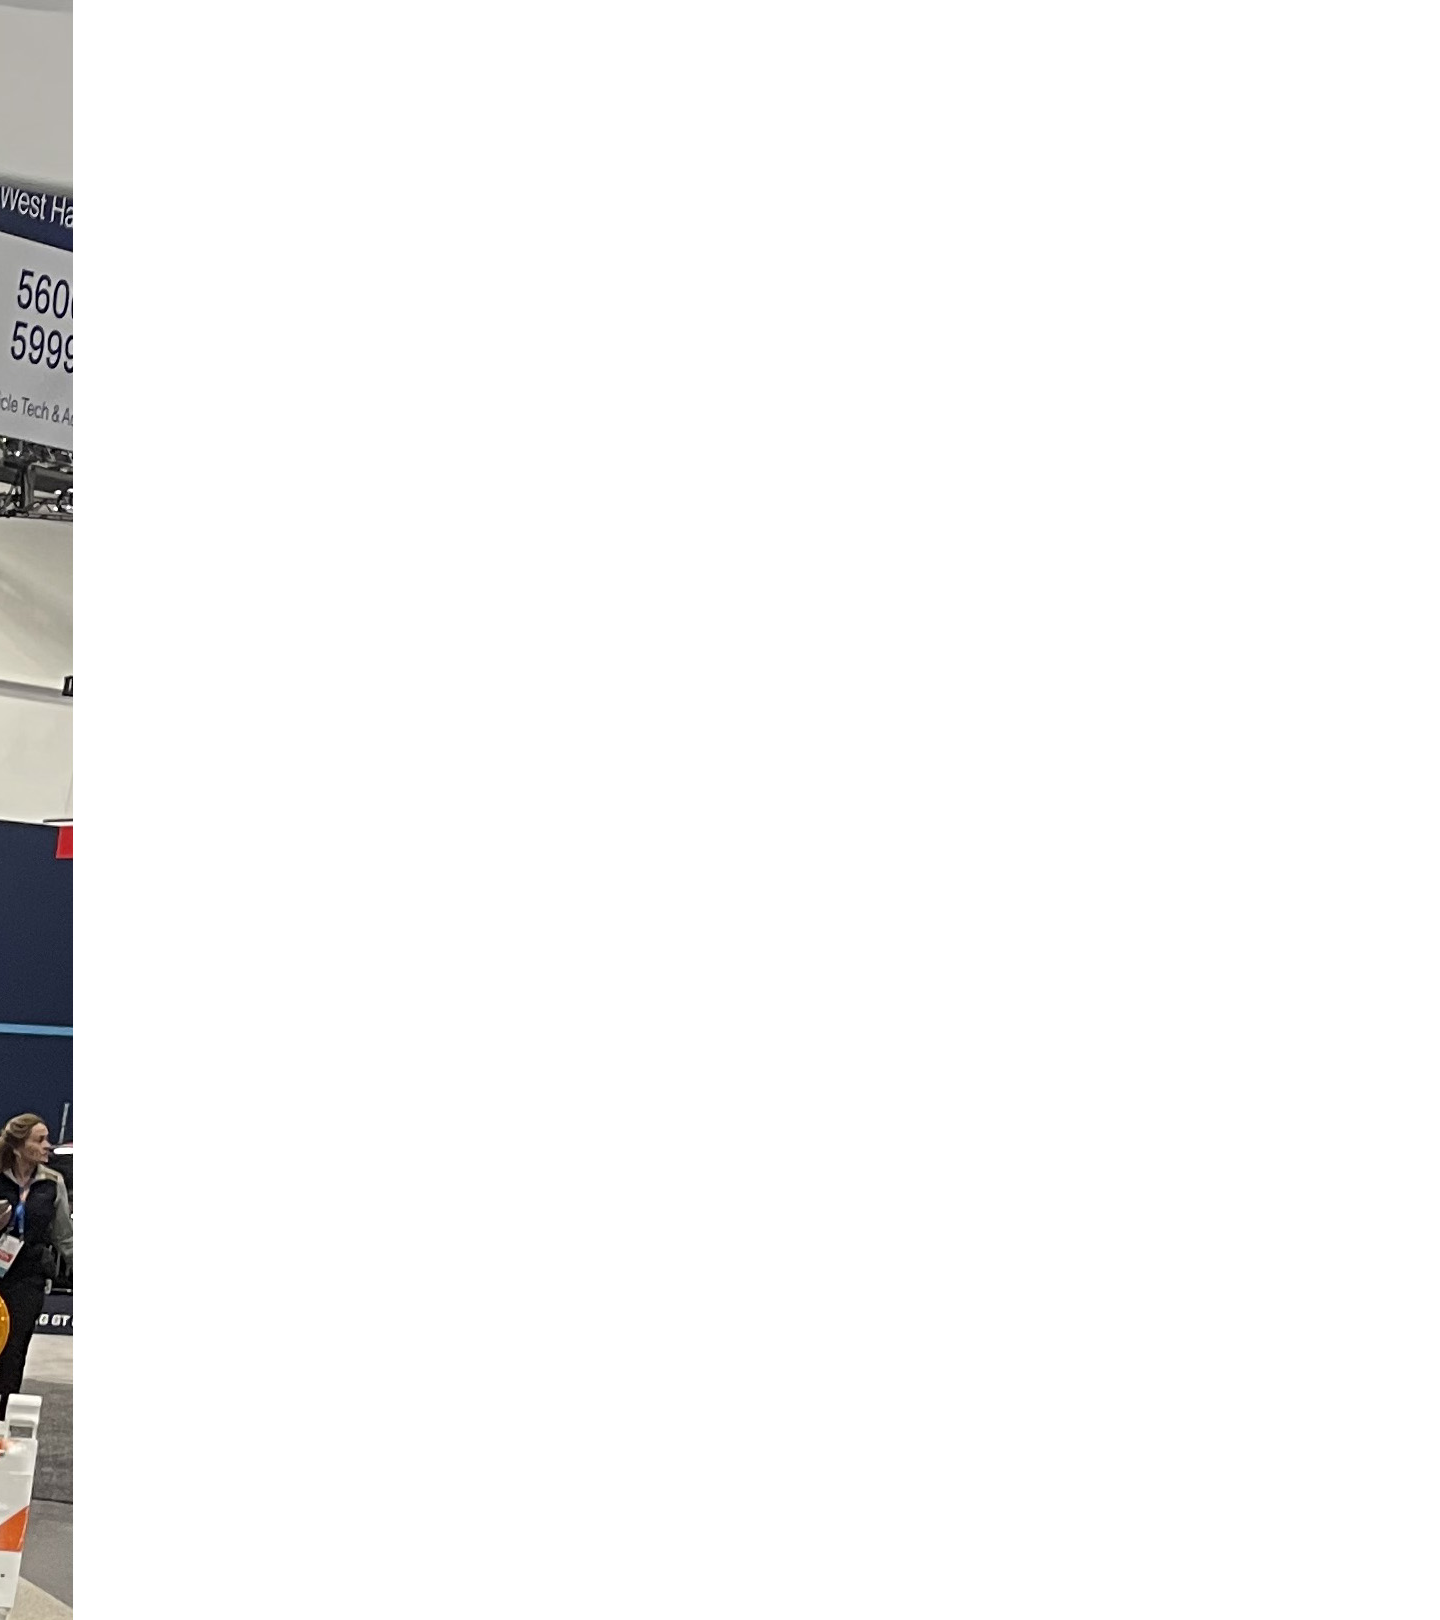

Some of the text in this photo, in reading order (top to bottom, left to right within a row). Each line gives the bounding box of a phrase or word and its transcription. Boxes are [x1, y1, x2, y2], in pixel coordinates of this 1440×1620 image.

[1, 185, 47, 221] West
[17, 269, 73, 319] 560
[10, 321, 73, 374] 5999
[21, 396, 49, 421] Tech
[51, 404, 61, 423] &
[62, 407, 73, 427] A
